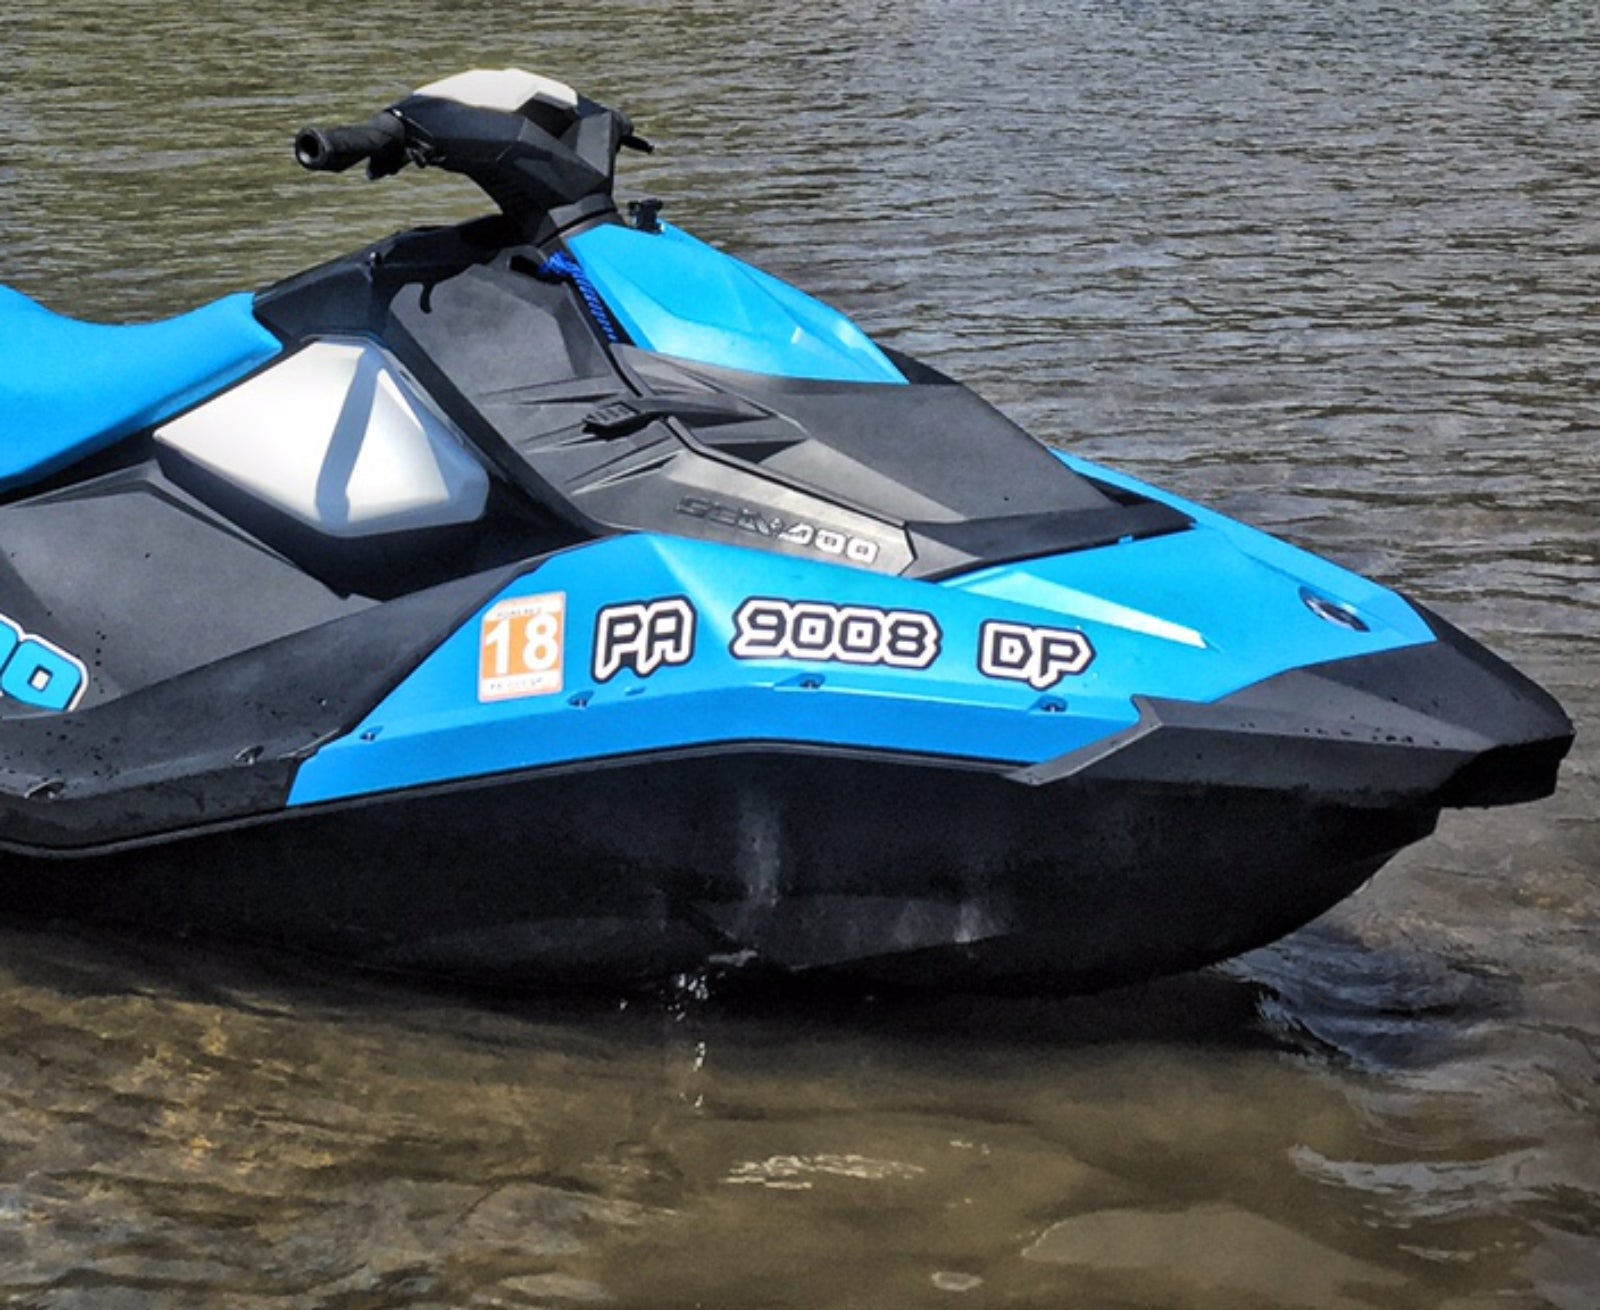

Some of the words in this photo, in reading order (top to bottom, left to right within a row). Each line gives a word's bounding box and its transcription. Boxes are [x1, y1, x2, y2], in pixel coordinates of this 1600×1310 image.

[485, 612, 559, 675] 18
[592, 595, 696, 683] PA
[729, 596, 943, 669] 9008
[978, 619, 1096, 691] DP
